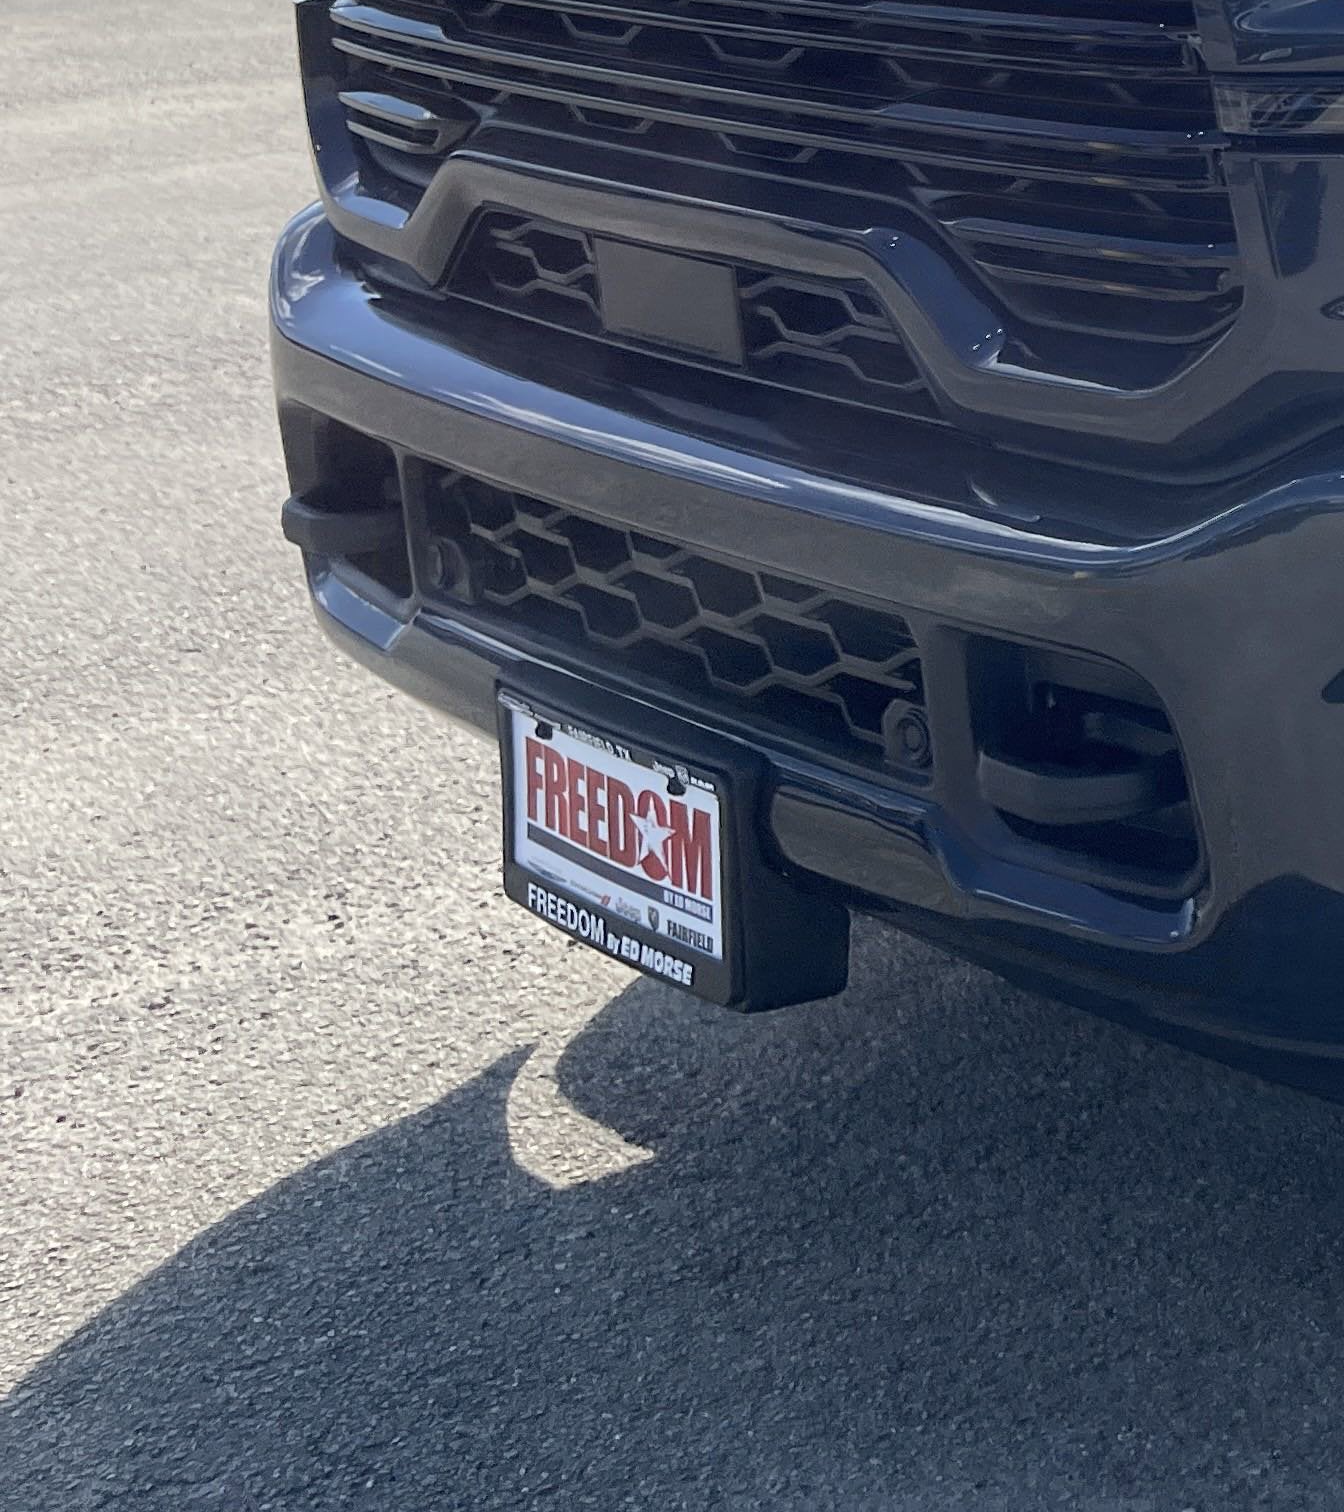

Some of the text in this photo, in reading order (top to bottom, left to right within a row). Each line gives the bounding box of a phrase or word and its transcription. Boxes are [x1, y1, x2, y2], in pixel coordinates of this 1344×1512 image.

[524, 736, 714, 902] FREEDOM
[527, 882, 605, 946] FREEDOM
[620, 935, 640, 963] ED
[640, 944, 693, 986] MORSE
[667, 919, 713, 954] FAIRFIELD
